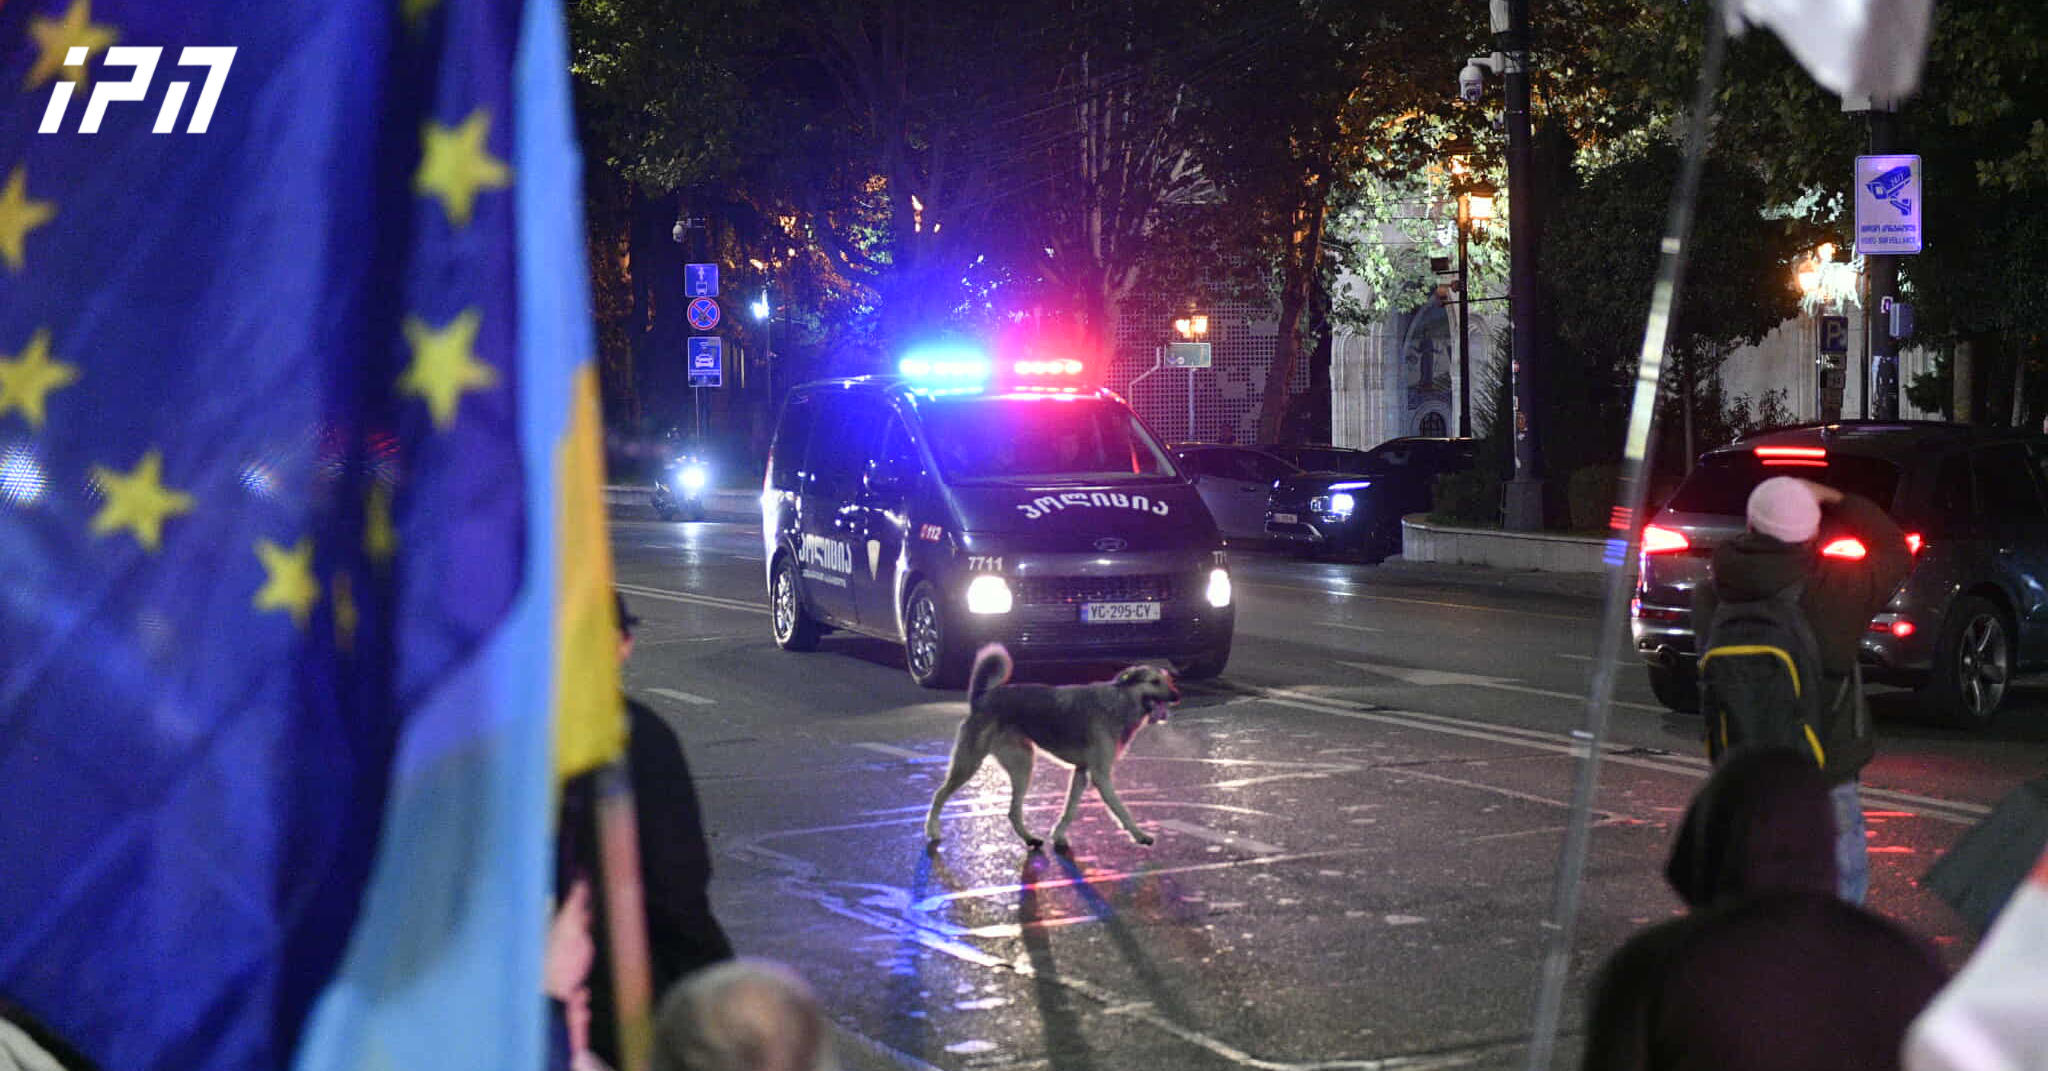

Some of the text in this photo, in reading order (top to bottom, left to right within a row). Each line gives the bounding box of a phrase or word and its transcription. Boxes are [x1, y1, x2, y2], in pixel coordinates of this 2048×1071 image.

[1016, 492, 1169, 519] პოლიცია
[927, 525, 943, 541] 112
[968, 556, 1003, 571] 7711
